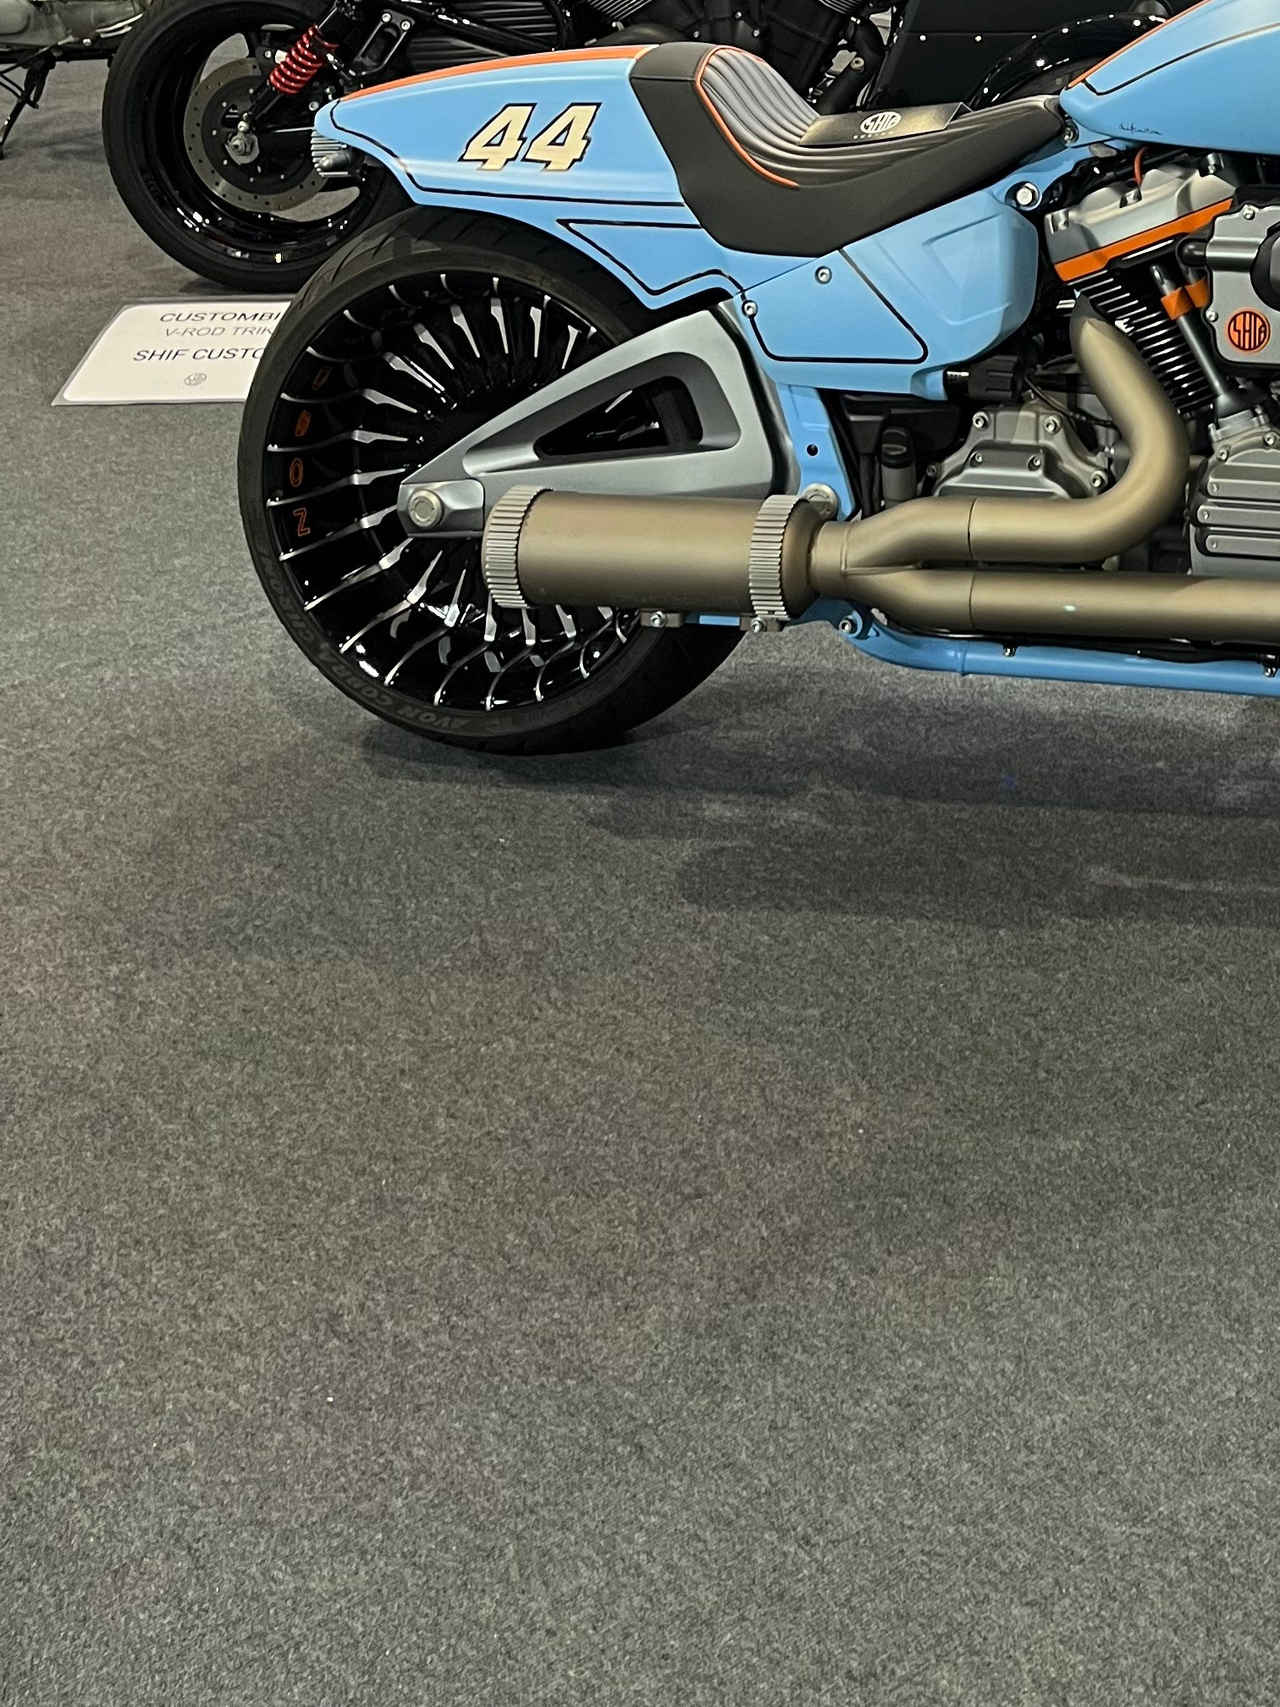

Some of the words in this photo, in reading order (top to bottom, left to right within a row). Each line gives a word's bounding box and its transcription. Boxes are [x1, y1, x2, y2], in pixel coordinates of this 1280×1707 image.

[457, 102, 603, 172] 44
[160, 312, 282, 323] CUSTOMBI
[165, 326, 226, 337] V-ROD
[133, 348, 190, 361] SHIF
